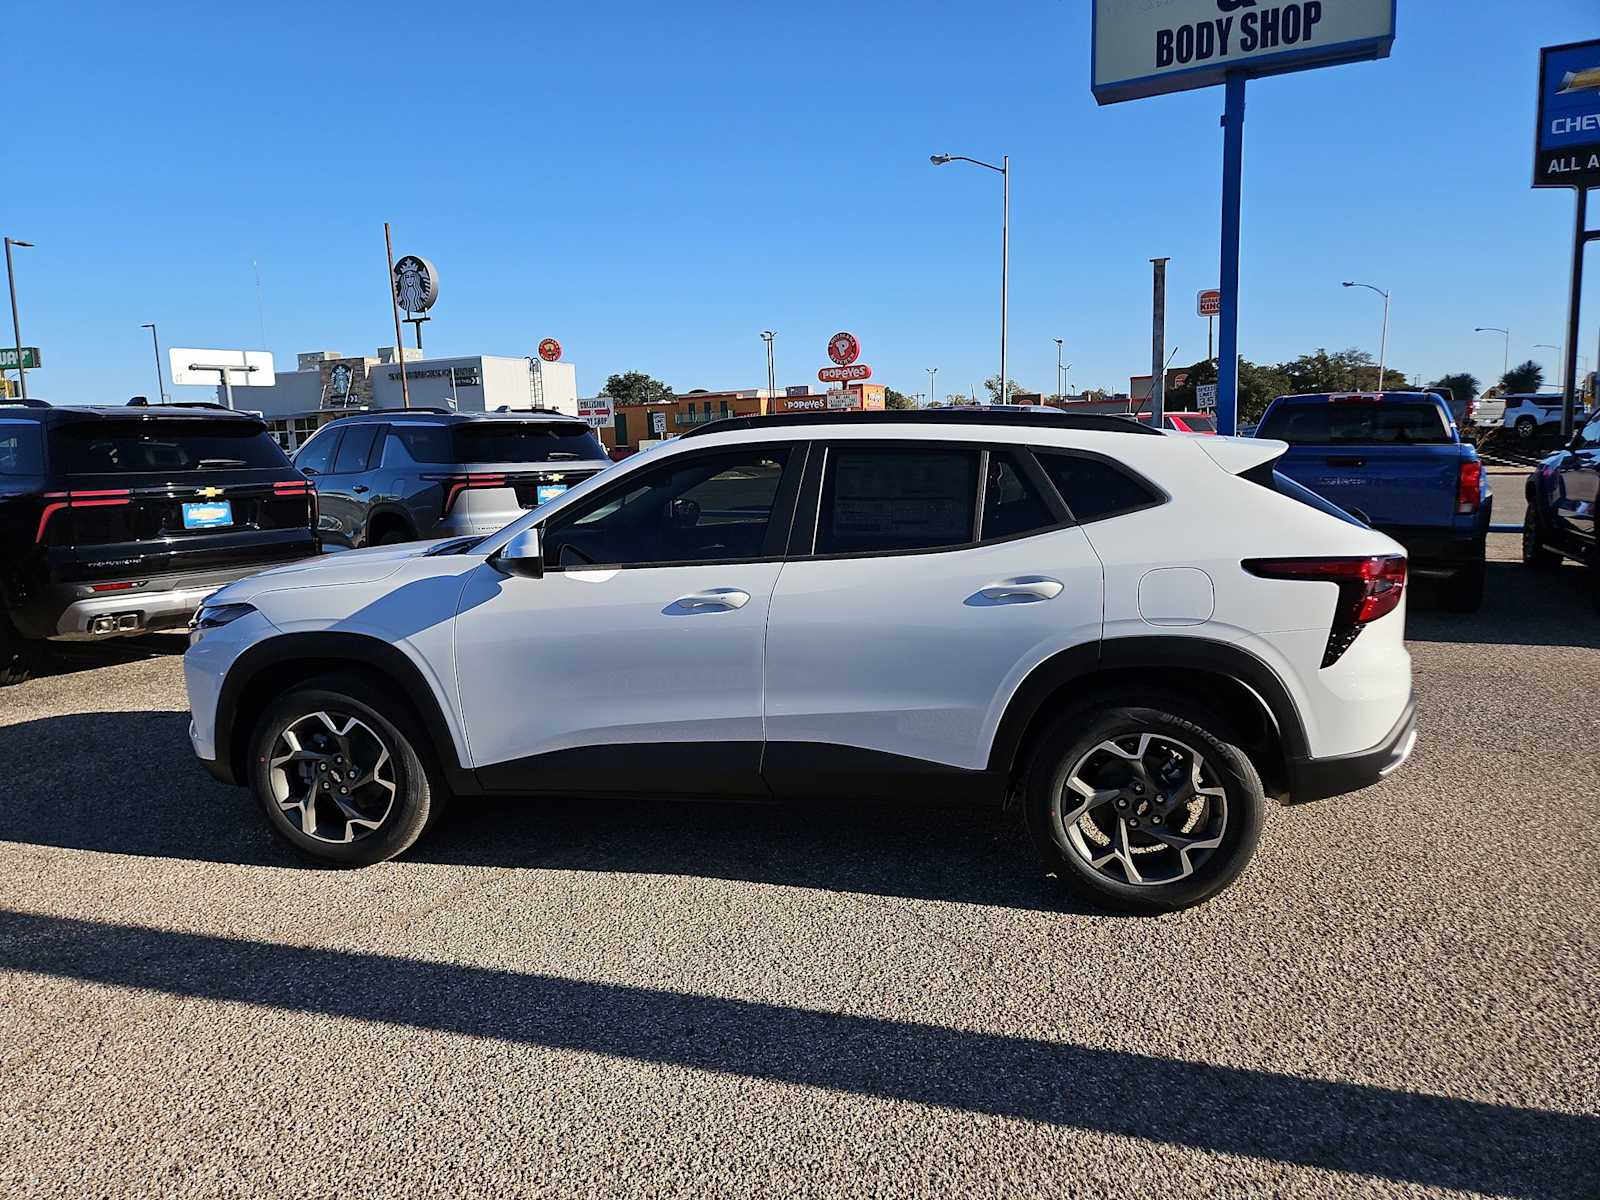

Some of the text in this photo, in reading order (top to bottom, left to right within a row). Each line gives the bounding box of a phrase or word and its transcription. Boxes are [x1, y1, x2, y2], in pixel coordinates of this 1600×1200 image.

[1156, 1, 1322, 68] BODY SHOP
[1547, 157, 1581, 174] ALL
[1199, 396, 1214, 406] 35
